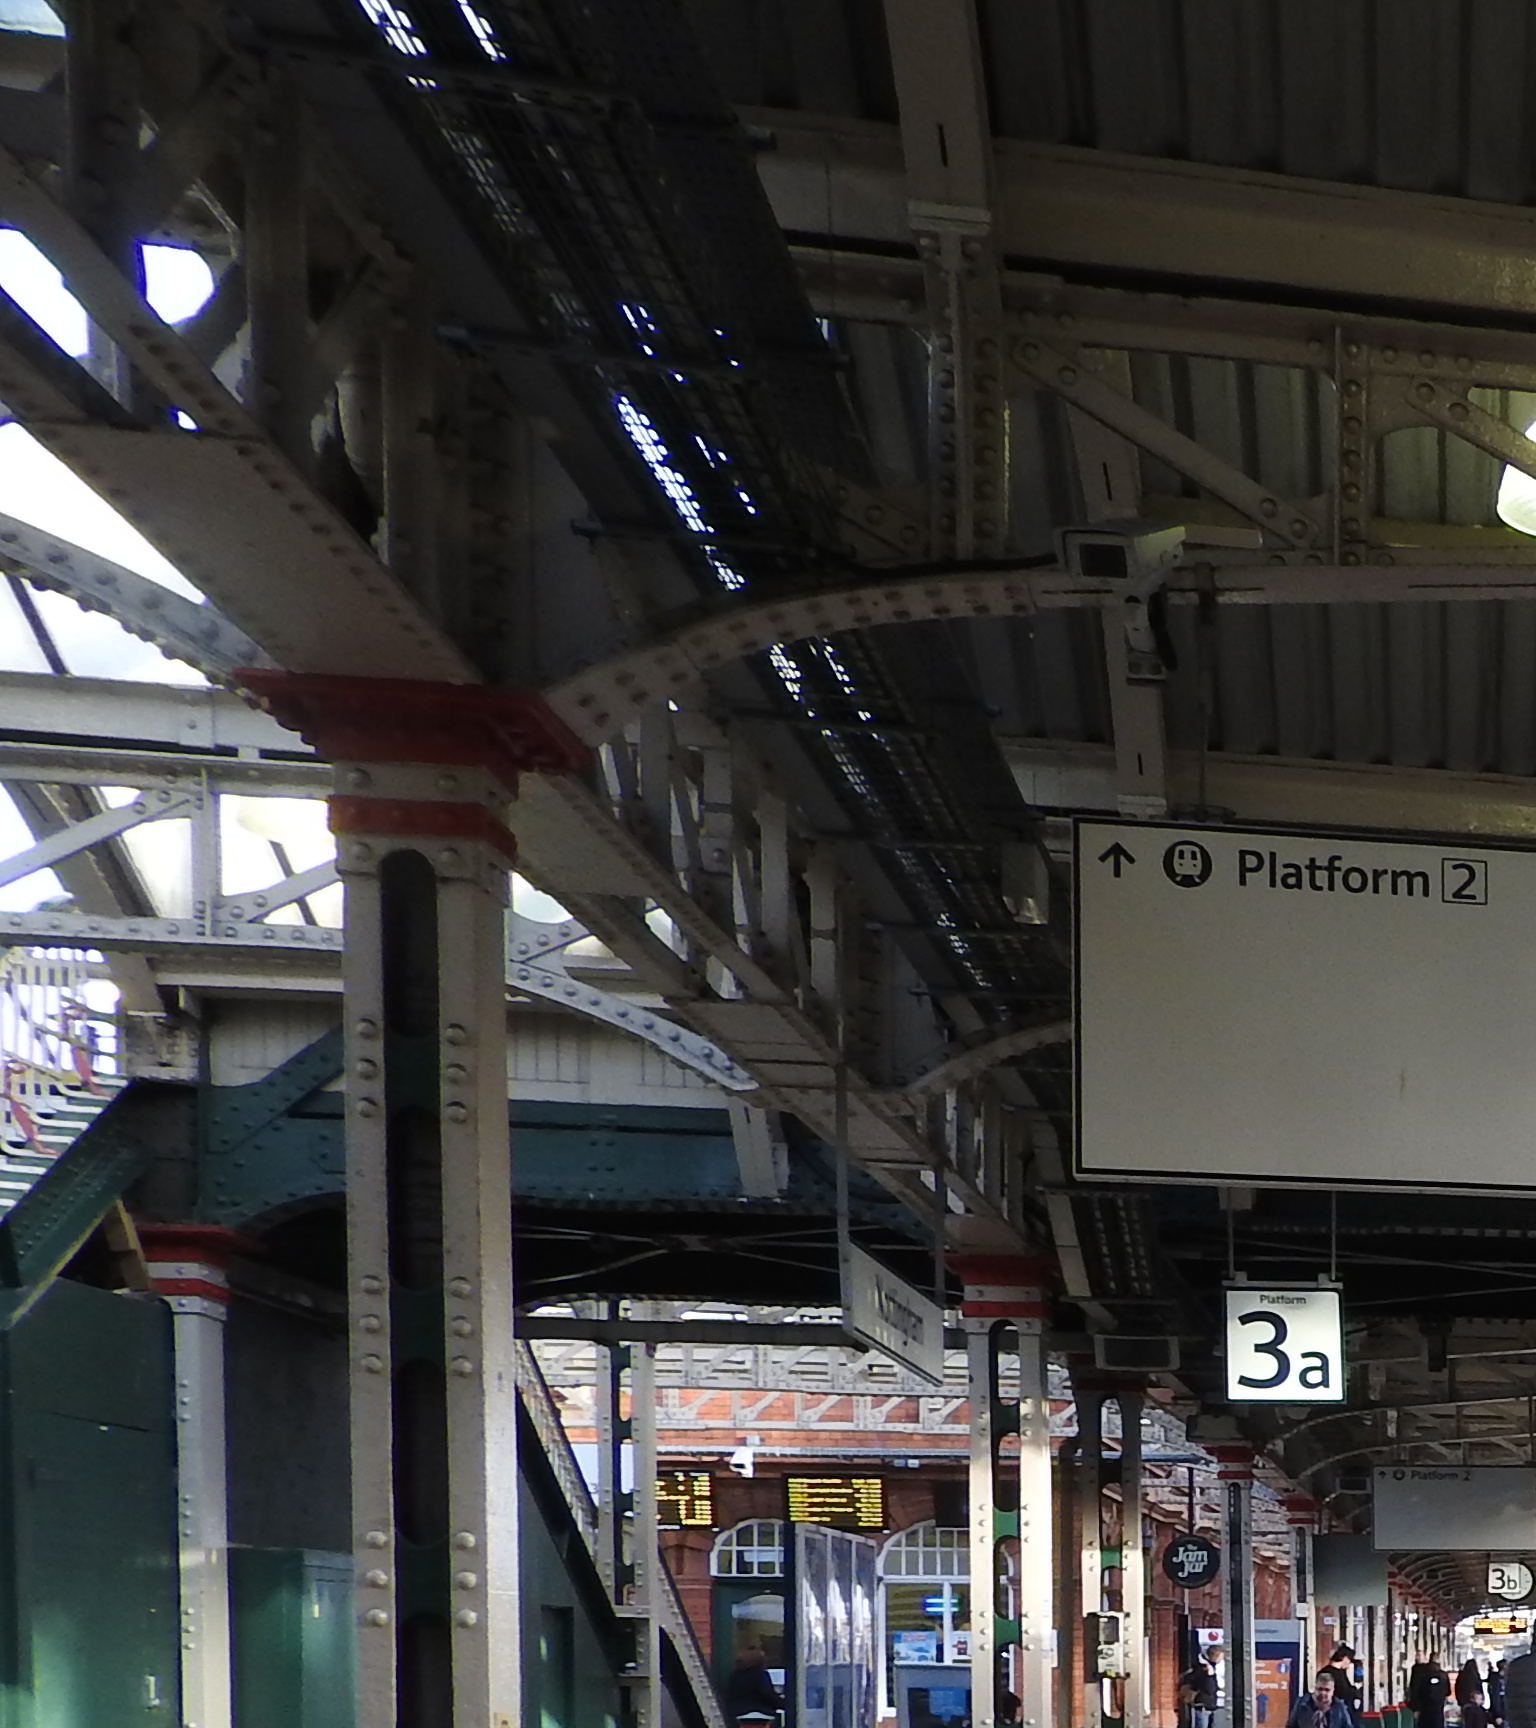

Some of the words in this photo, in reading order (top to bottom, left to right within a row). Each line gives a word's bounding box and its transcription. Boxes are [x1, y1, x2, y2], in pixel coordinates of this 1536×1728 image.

[1236, 848, 1431, 898] Platform
[1450, 862, 1478, 900] 2
[1259, 1294, 1307, 1305] Platform
[1237, 1310, 1330, 1389] 3a
[1411, 1469, 1459, 1481] Platform
[1463, 1471, 1471, 1482] 2
[1172, 1546, 1208, 1563] Jam
[1491, 1568, 1518, 1590] 3b
